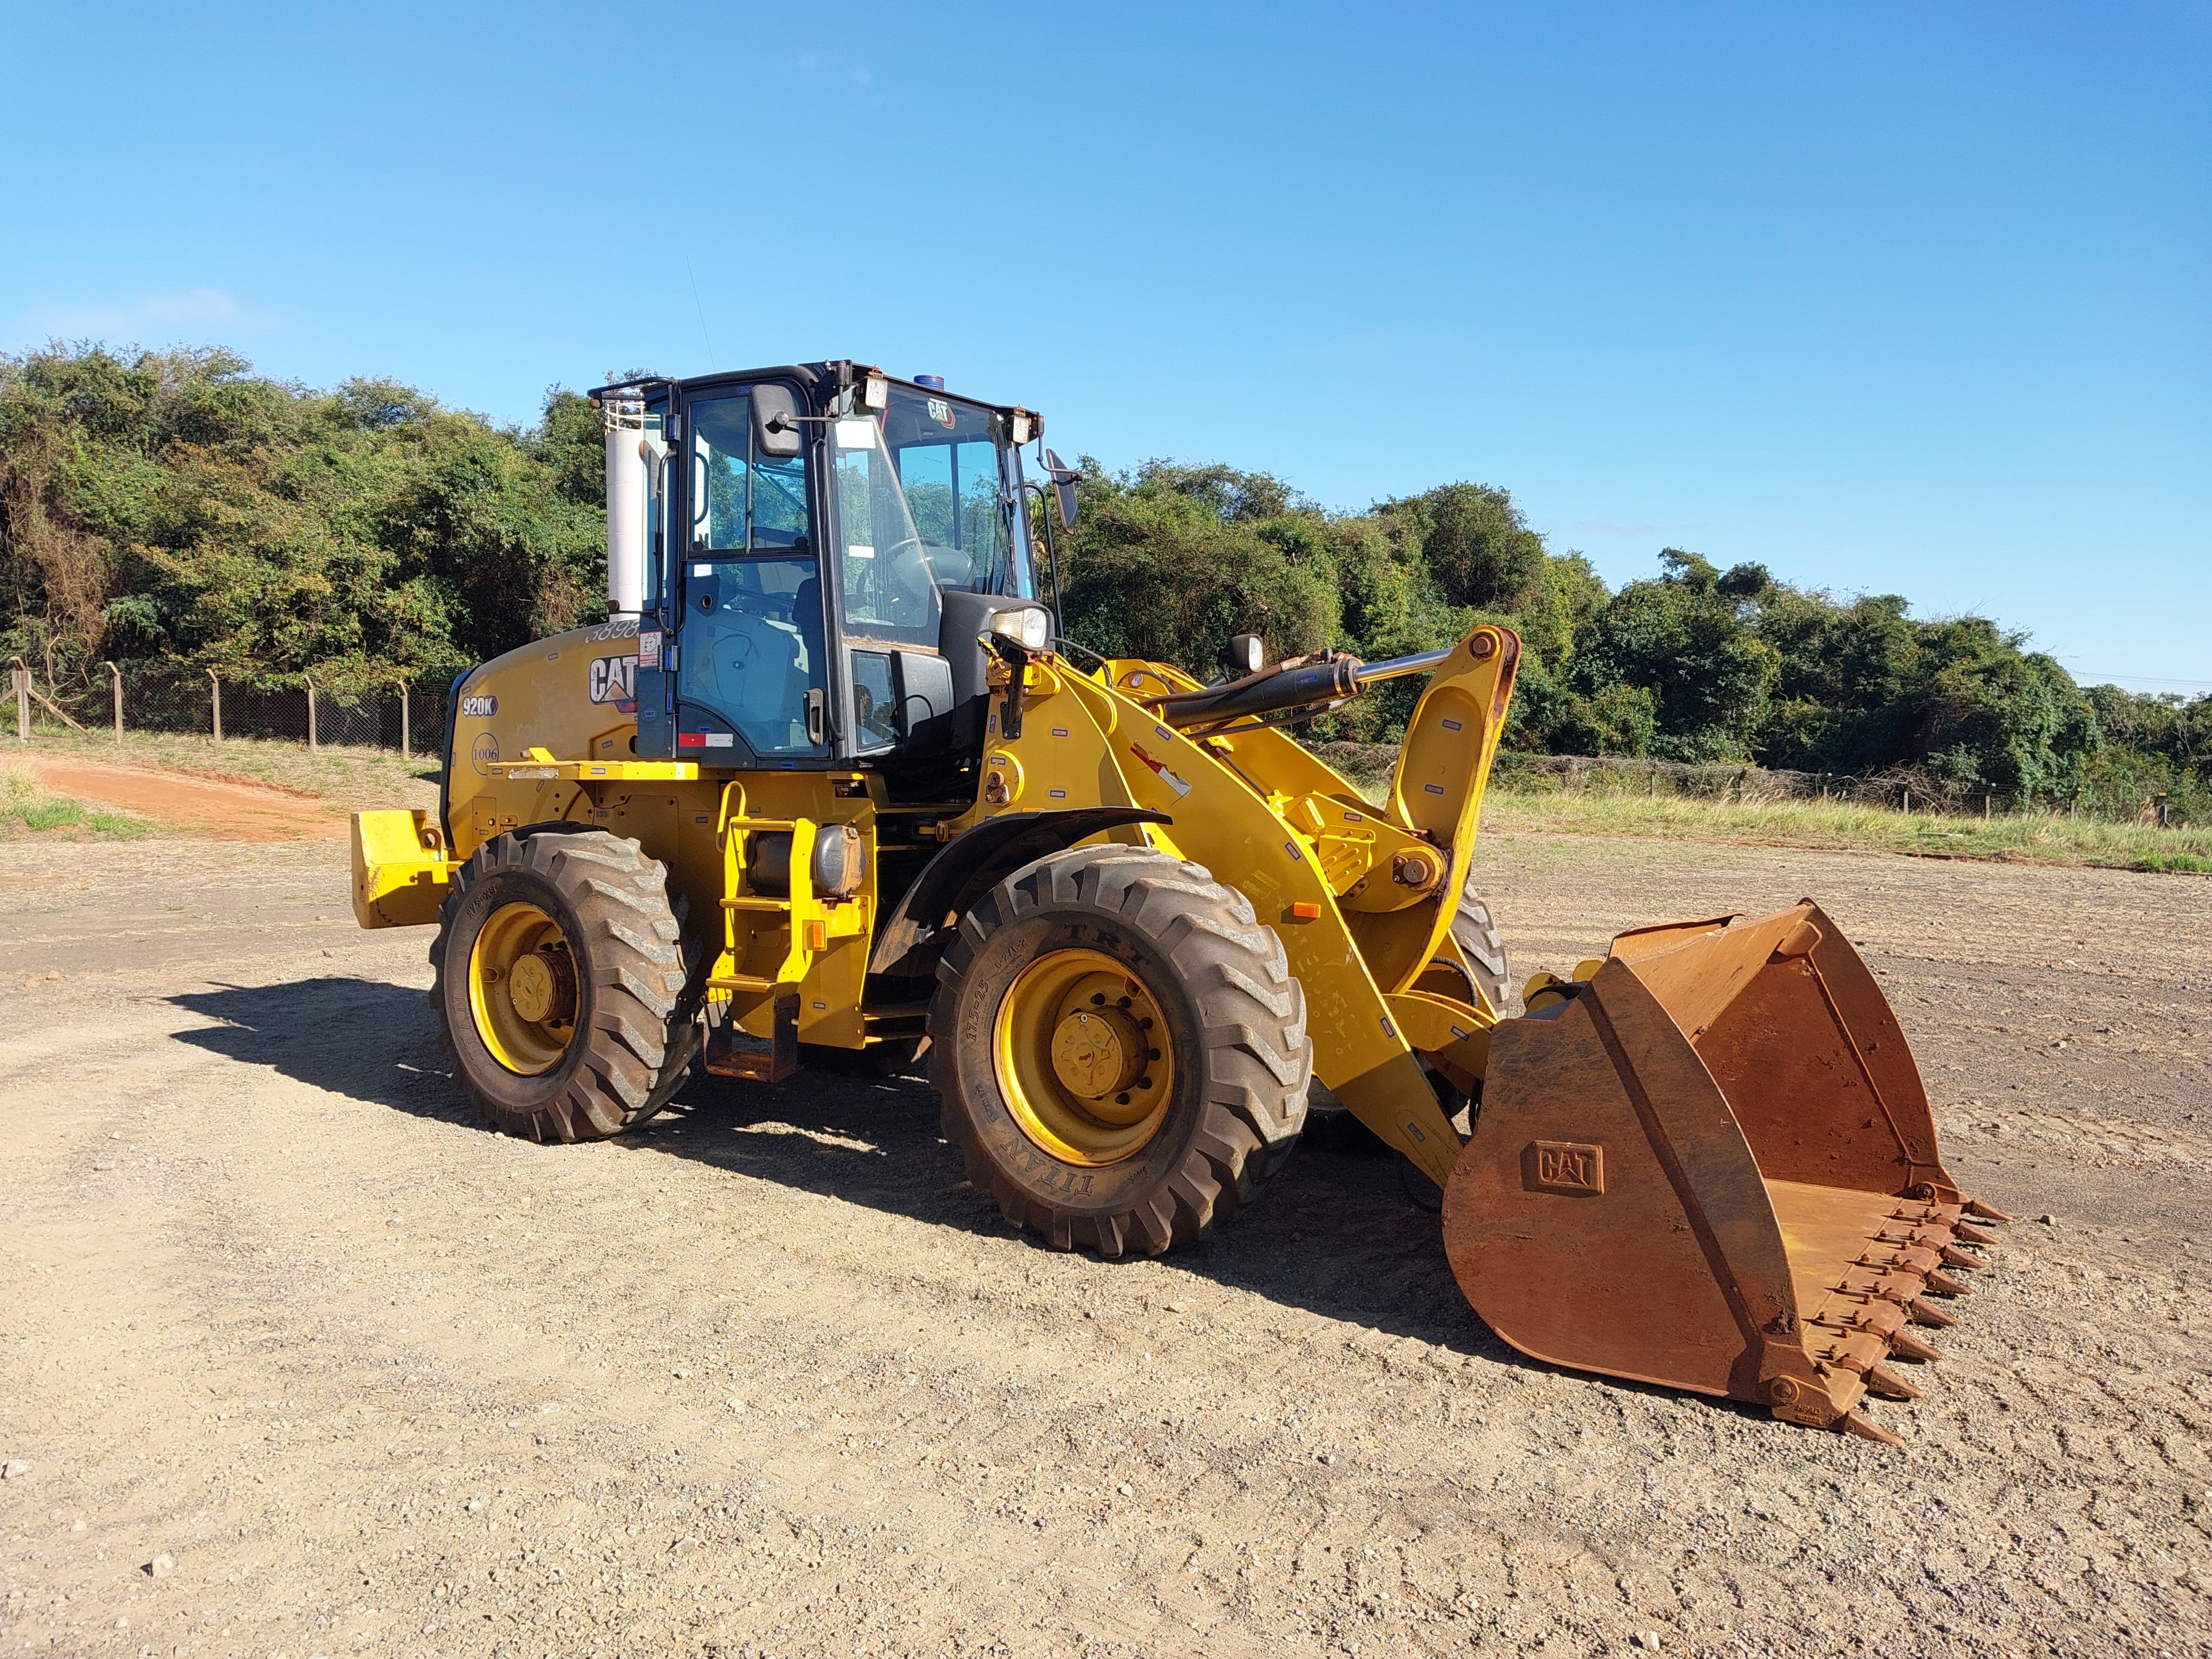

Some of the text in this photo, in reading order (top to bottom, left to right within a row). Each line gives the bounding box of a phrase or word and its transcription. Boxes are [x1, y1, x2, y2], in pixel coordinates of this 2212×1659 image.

[927, 401, 948, 422] CAT
[585, 619, 640, 644] 3898
[590, 656, 638, 702] CAT
[463, 696, 493, 716] 920K
[474, 748, 498, 760] 1006
[1064, 921, 1151, 965] TRT
[966, 977, 990, 1043] 17.5-25
[452, 995, 493, 1074] TITAN
[999, 1137, 1094, 1197] TITAN
[1539, 1149, 1592, 1187] CAT
